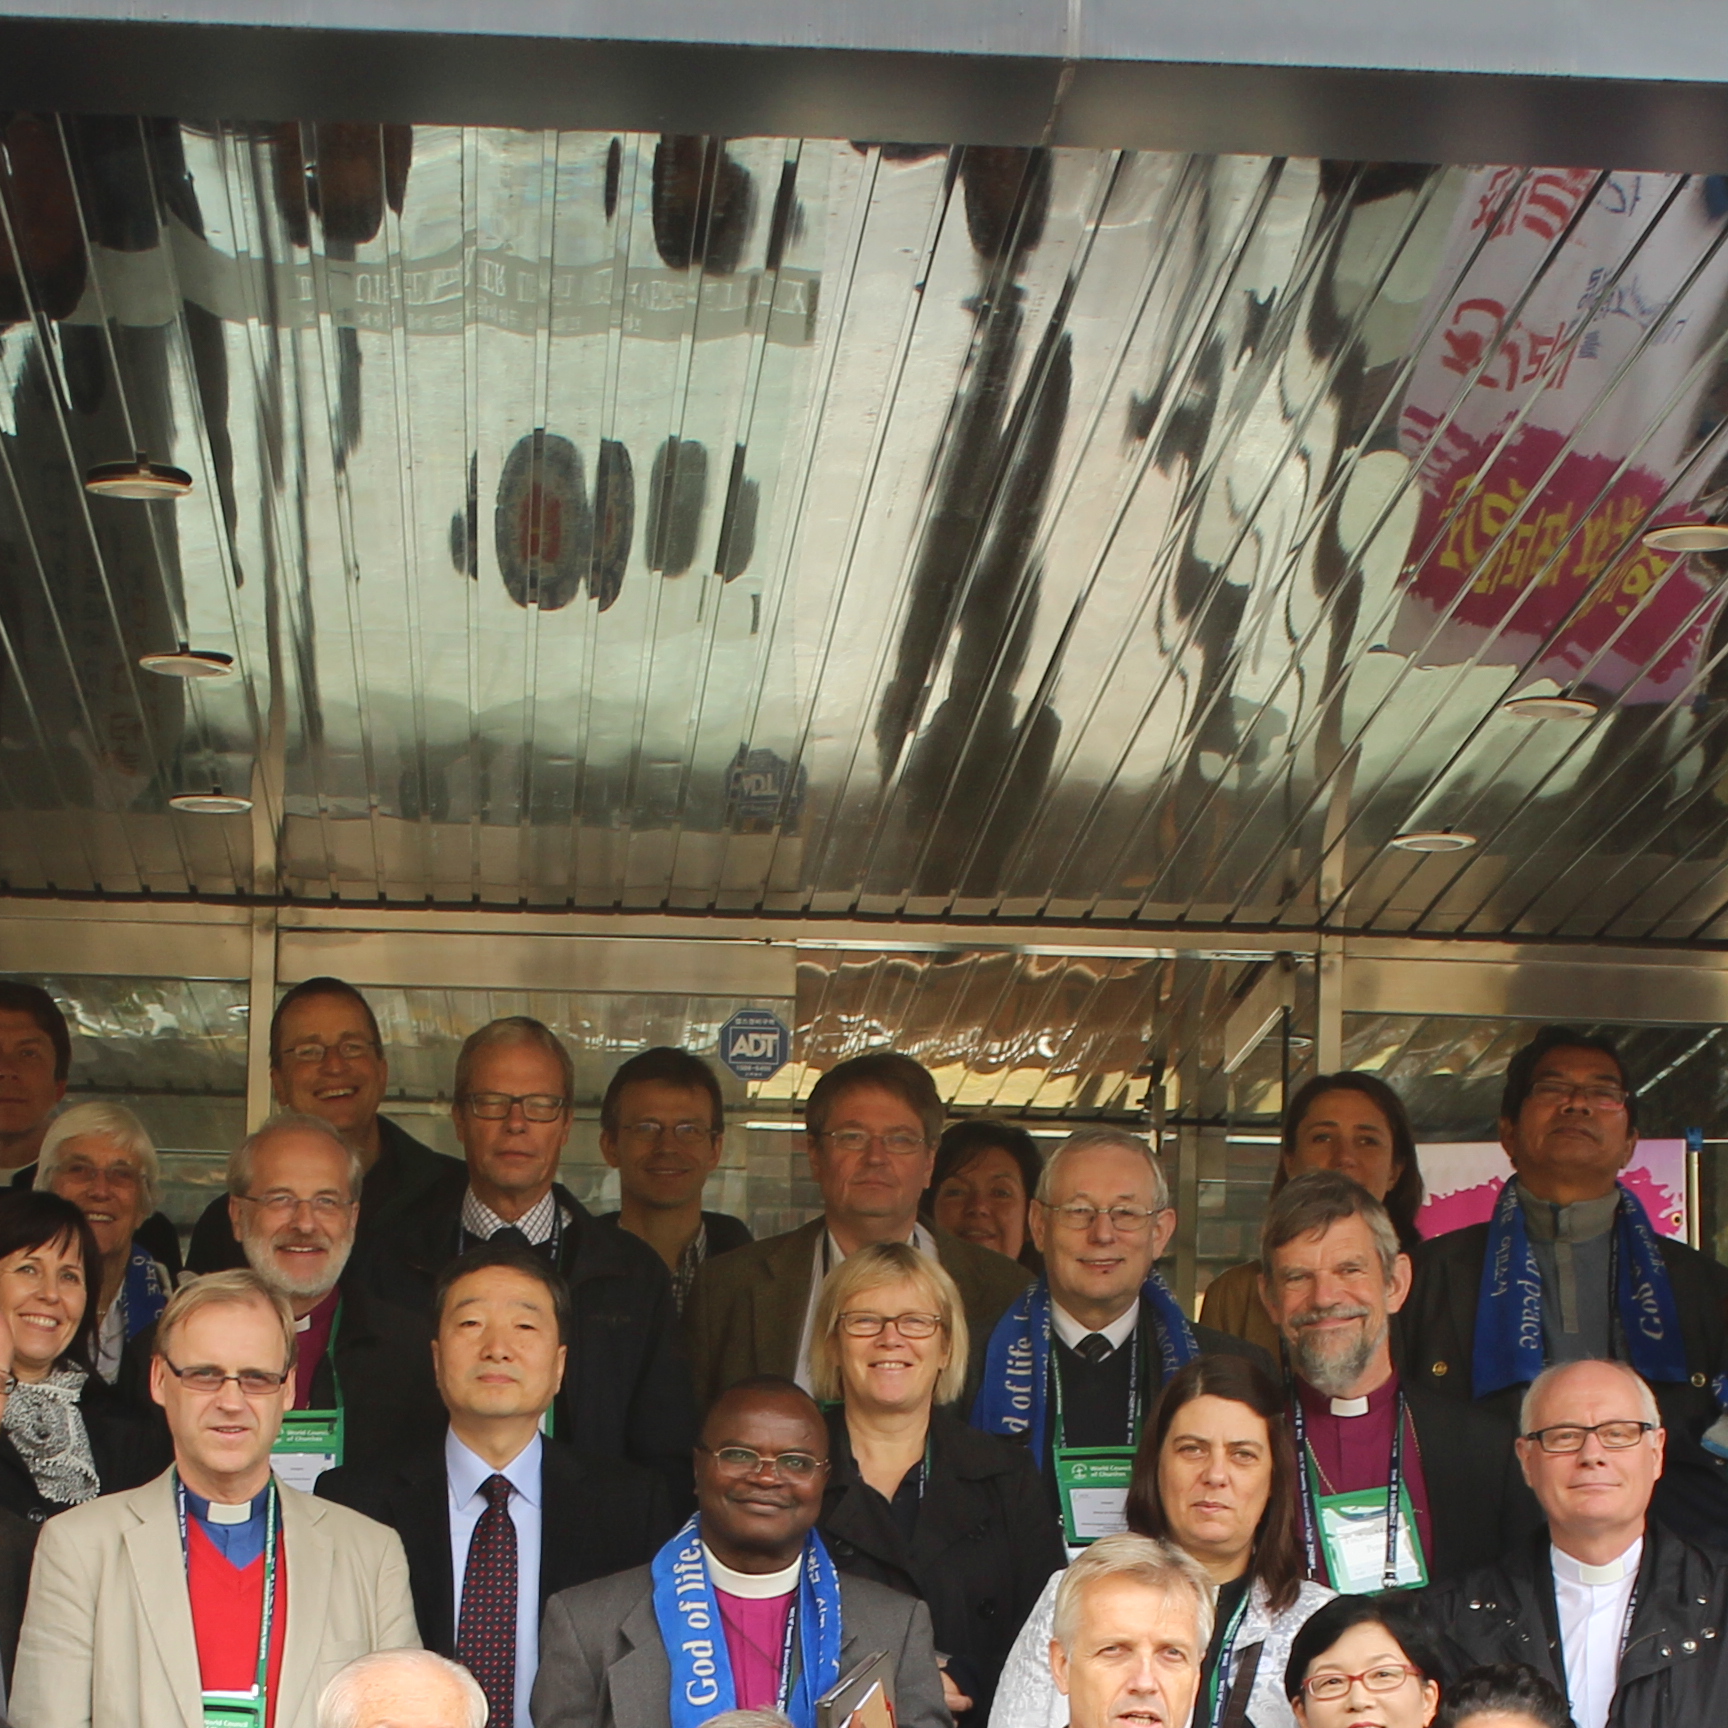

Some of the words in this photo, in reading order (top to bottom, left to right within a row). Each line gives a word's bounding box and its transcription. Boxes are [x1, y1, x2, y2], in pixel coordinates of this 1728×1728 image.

[730, 1033, 780, 1058] ADT
[1005, 1380, 1032, 1410] of
[678, 1601, 711, 1629] of
[685, 1639, 719, 1706] God
[223, 1719, 248, 1728] Council
